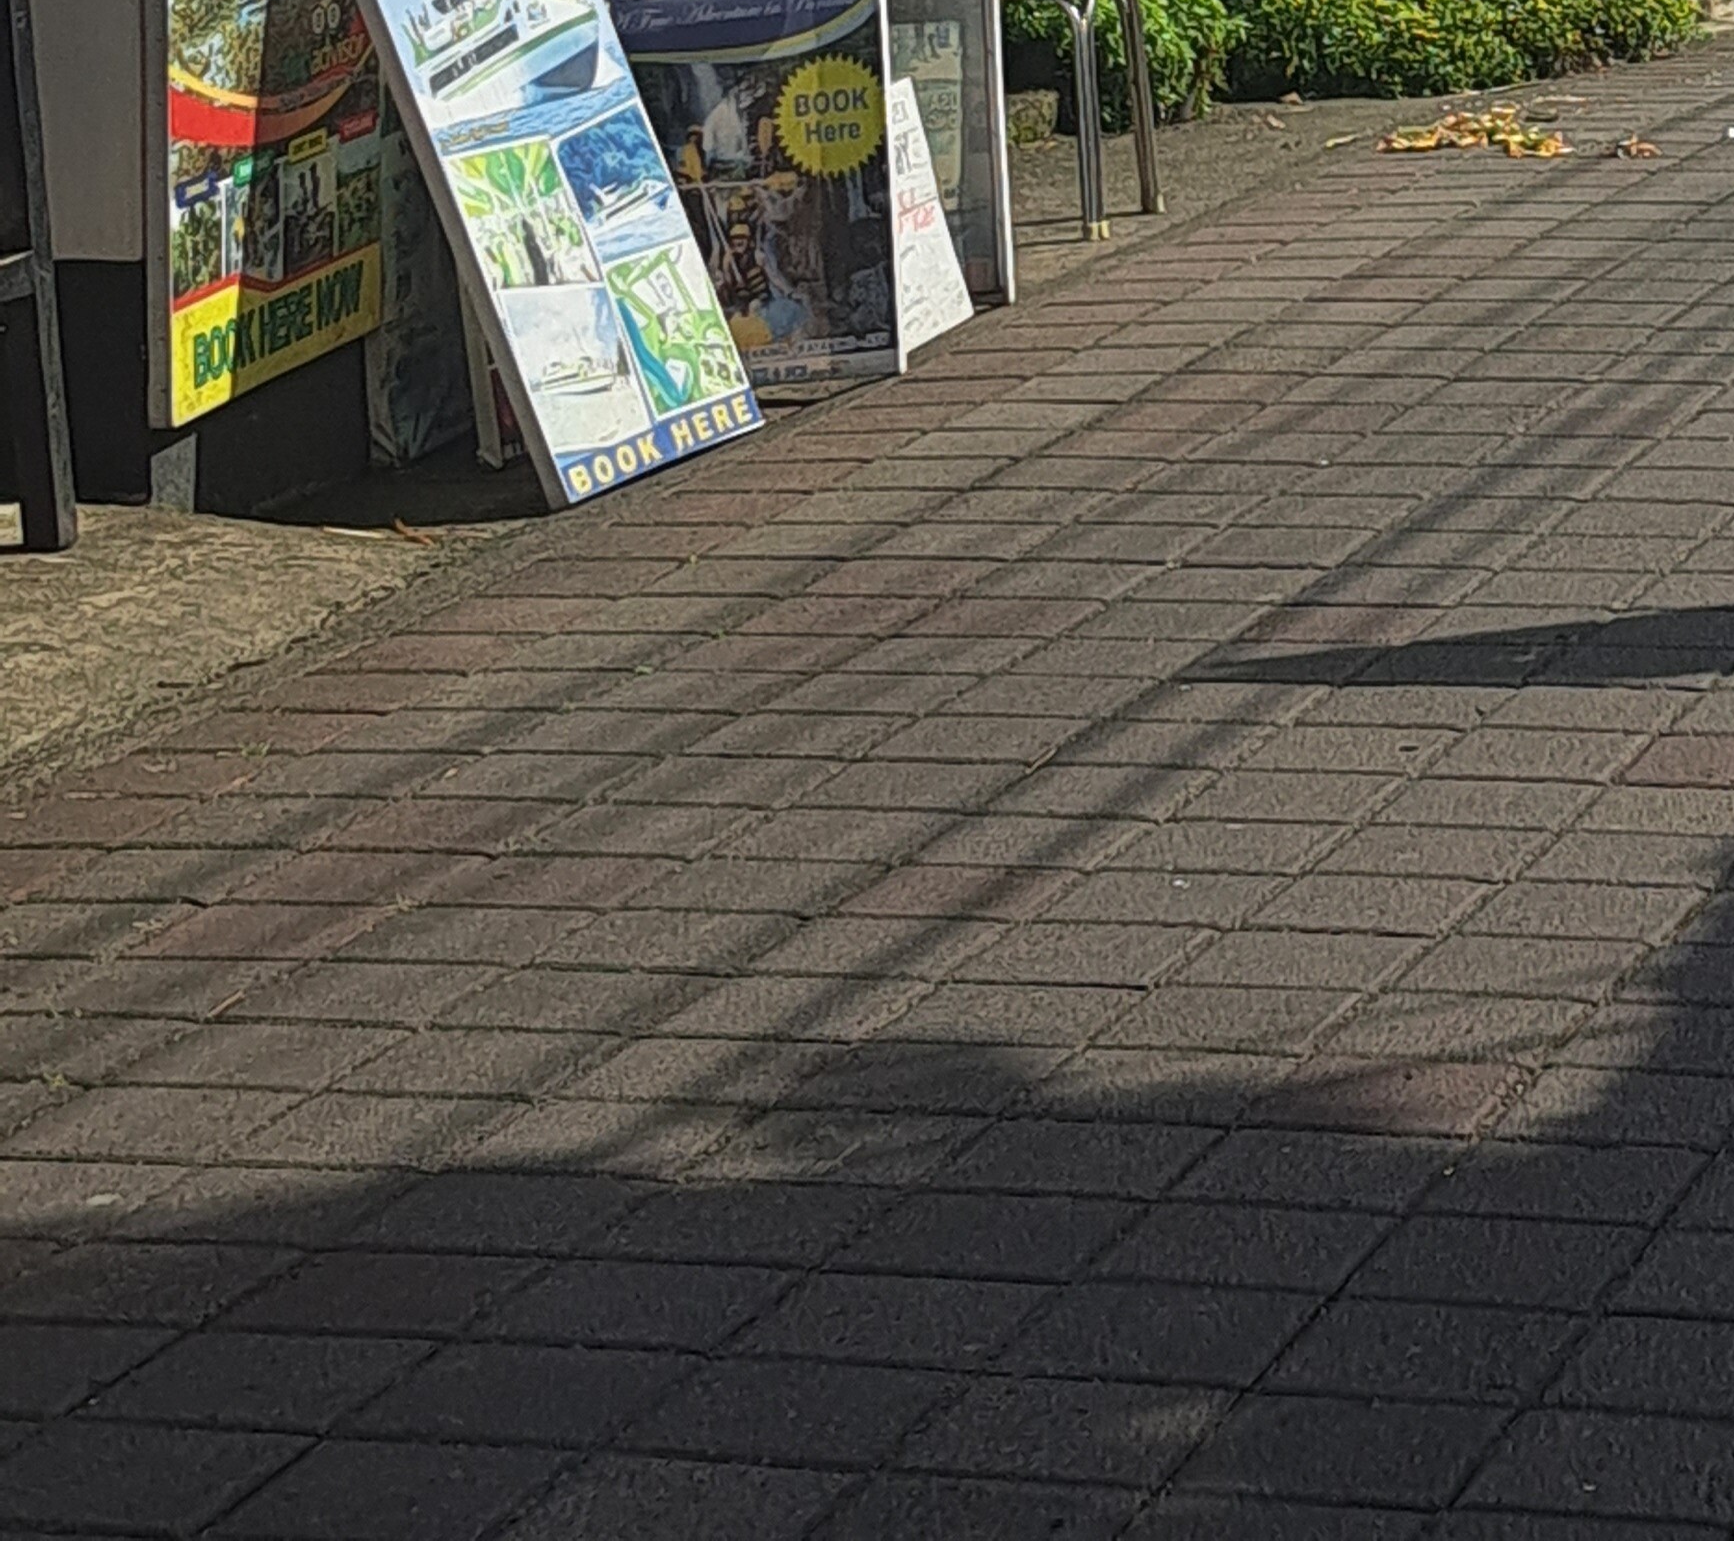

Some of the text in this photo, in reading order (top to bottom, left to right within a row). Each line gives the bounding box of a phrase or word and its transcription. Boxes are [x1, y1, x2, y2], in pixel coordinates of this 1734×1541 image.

[794, 86, 870, 117] BOOK
[805, 121, 861, 143] Here
[193, 259, 364, 390] BOOK HERE NOW
[567, 393, 754, 495] BOOK HERE
